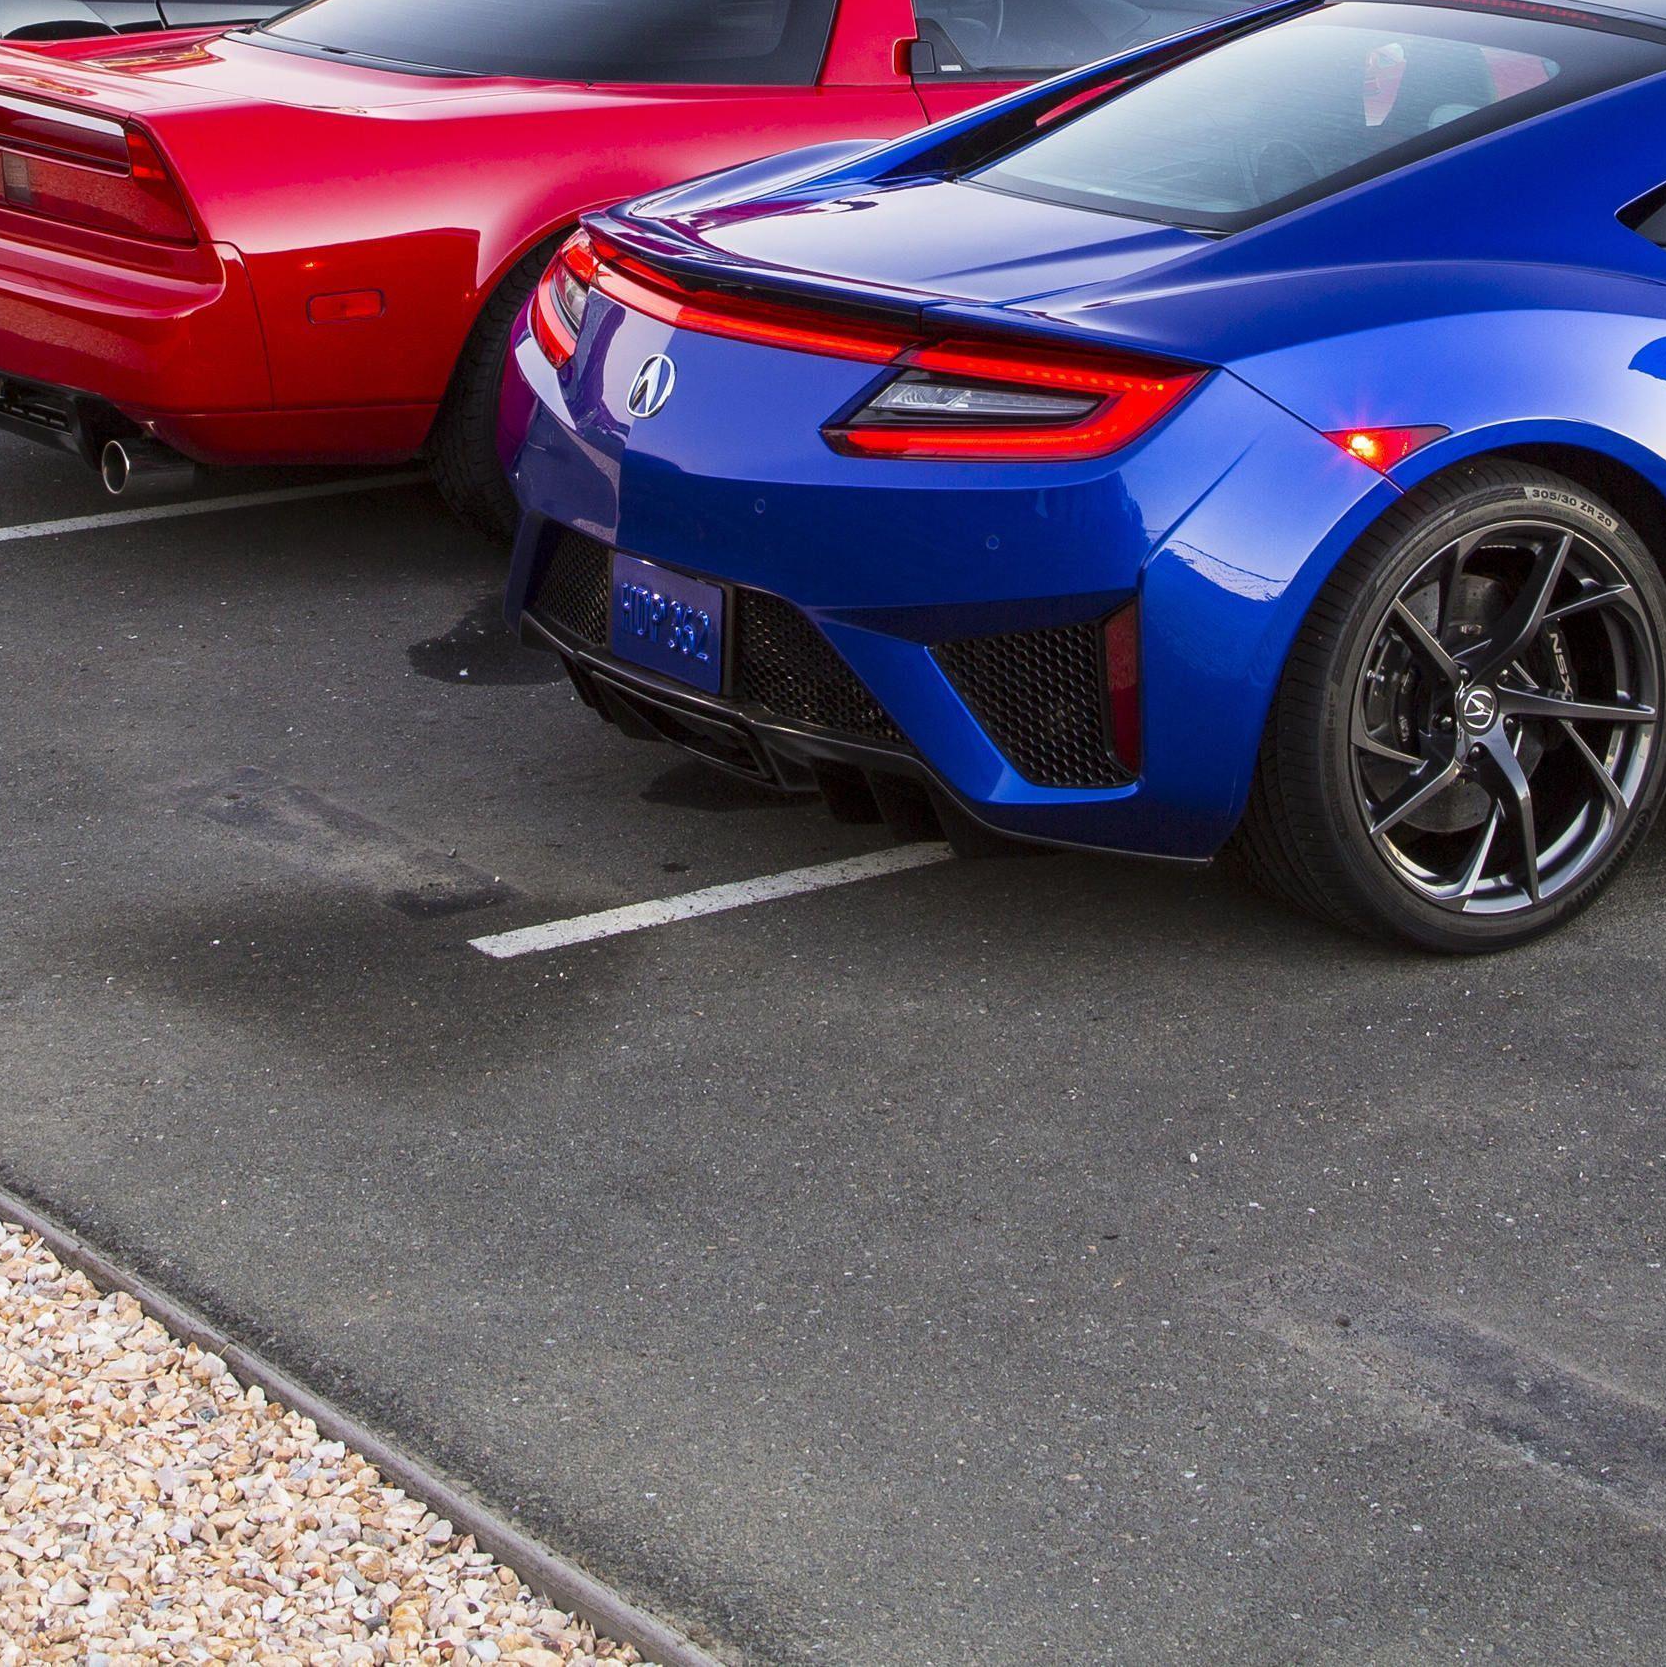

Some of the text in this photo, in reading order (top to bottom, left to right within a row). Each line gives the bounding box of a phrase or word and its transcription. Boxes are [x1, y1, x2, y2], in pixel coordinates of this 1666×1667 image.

[1532, 488, 1577, 507] 305/30
[1580, 501, 1595, 516] ZR
[1596, 511, 1613, 528] 20
[1548, 633, 1574, 694] NSX
